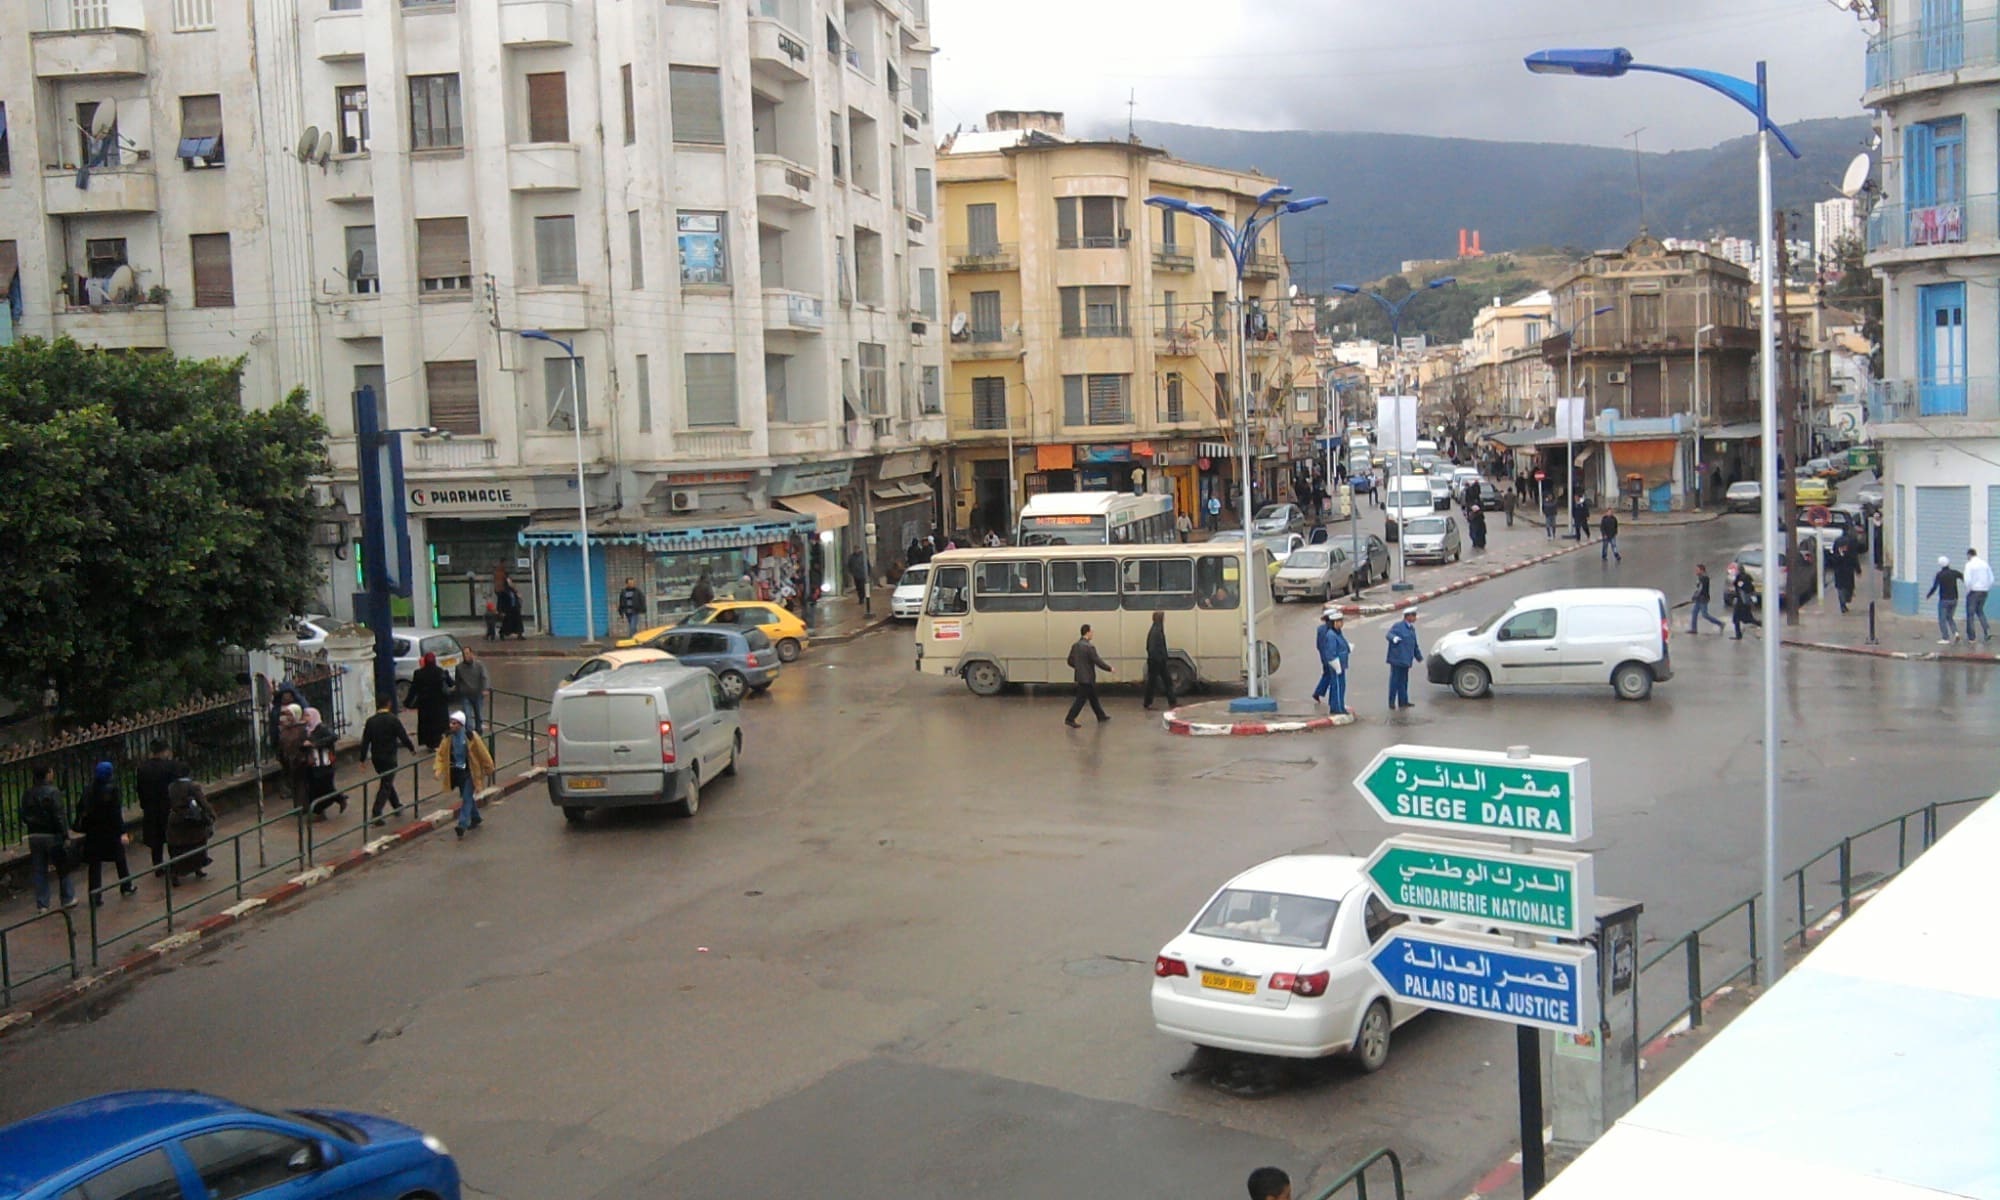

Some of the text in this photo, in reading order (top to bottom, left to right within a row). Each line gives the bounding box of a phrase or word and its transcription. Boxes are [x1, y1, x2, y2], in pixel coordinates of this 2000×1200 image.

[430, 489, 512, 504] PHARMACIE
[1395, 761, 1561, 801] مقر الدائرة
[1396, 794, 1562, 831] SIEGE DAIRA
[1399, 857, 1564, 893] الدرك الوطني
[1400, 884, 1566, 926] GENDARMERIE NATIONALE
[1403, 943, 1570, 992] قصر العدالة
[1404, 974, 1570, 1023] PALAIS DE LA JUSTICE
